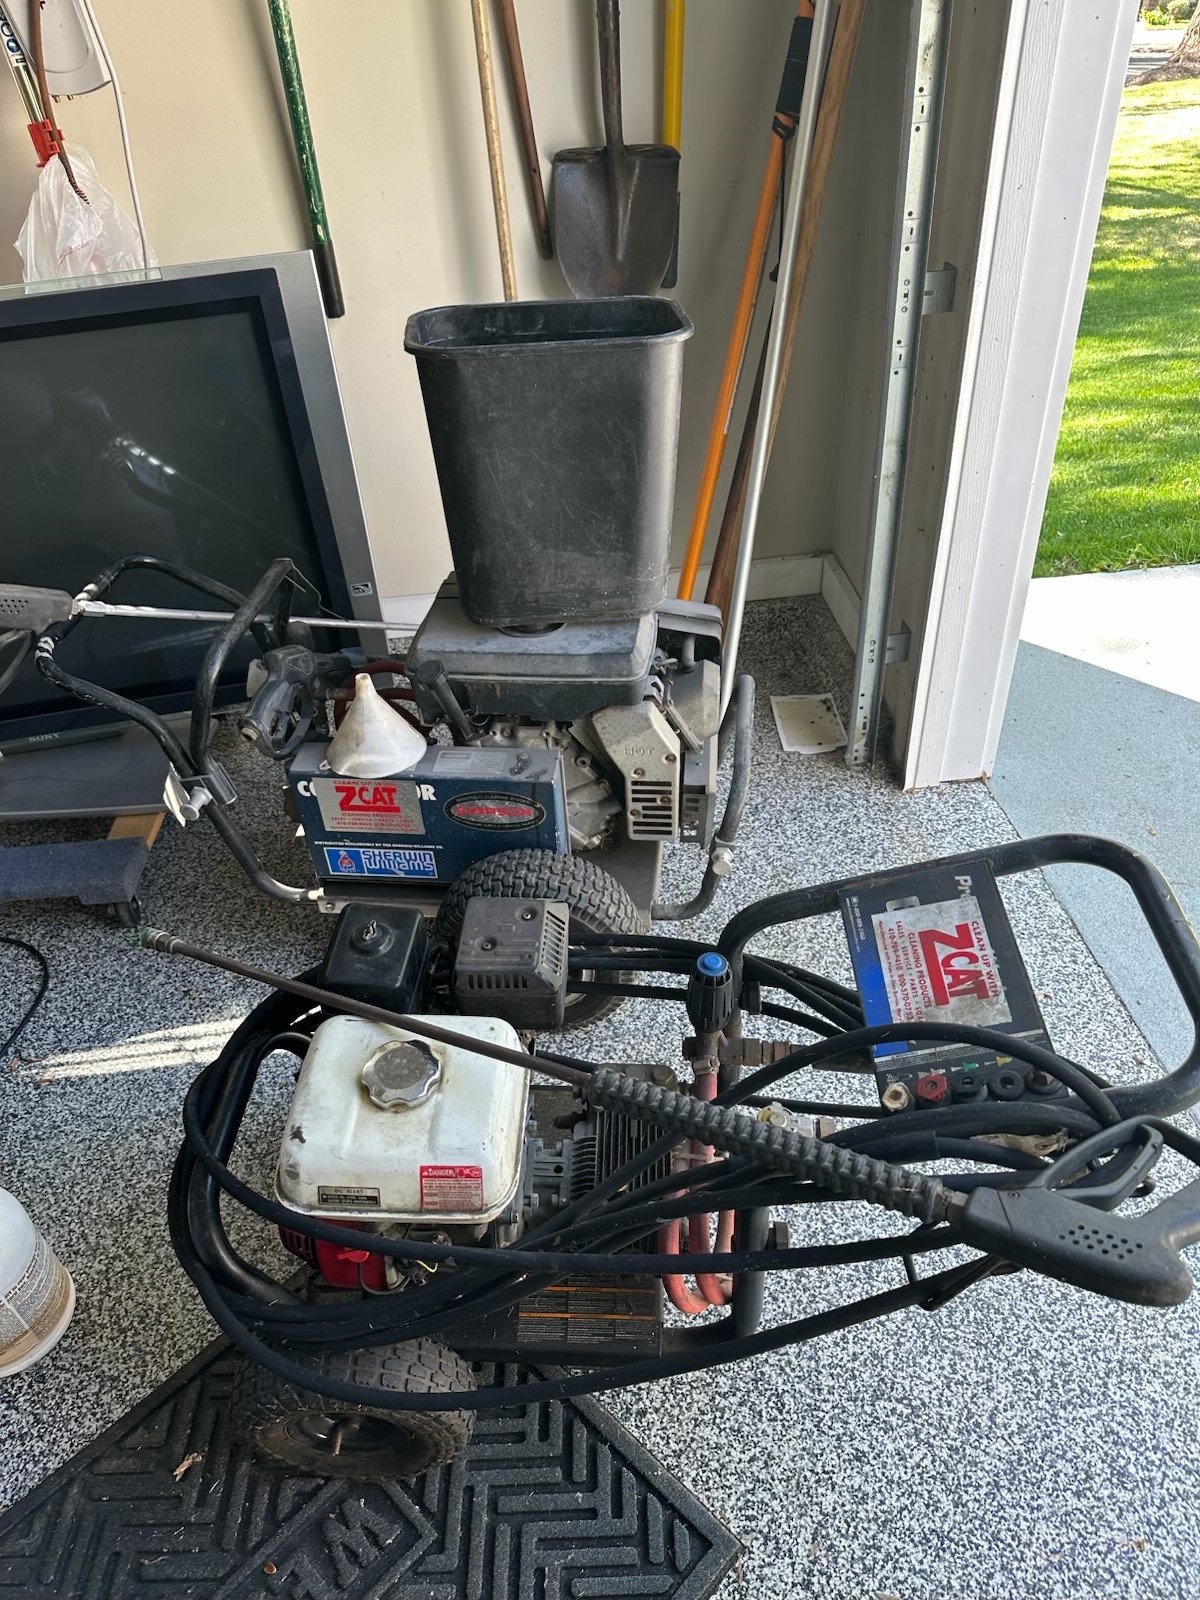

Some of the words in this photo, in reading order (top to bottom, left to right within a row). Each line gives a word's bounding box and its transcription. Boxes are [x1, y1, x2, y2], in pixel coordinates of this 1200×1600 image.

[29, 732, 60, 743] SONY
[624, 747, 655, 756] HOT
[335, 786, 400, 812] ZCAT
[455, 805, 533, 817] SIMPSON
[362, 850, 432, 862] SHERWIN
[971, 920, 988, 952] CLEAN
[896, 920, 905, 938] SALES
[901, 946, 912, 971] SERVICE
[909, 978, 919, 998] PARTS
[907, 932, 922, 969] CLEANING
[916, 969, 932, 1008] PRODUCTS
[918, 923, 990, 1006] ZCAT
[981, 954, 992, 968] UP
[897, 973, 914, 1020] 800-570-0752
[986, 970, 1000, 997] WITH
